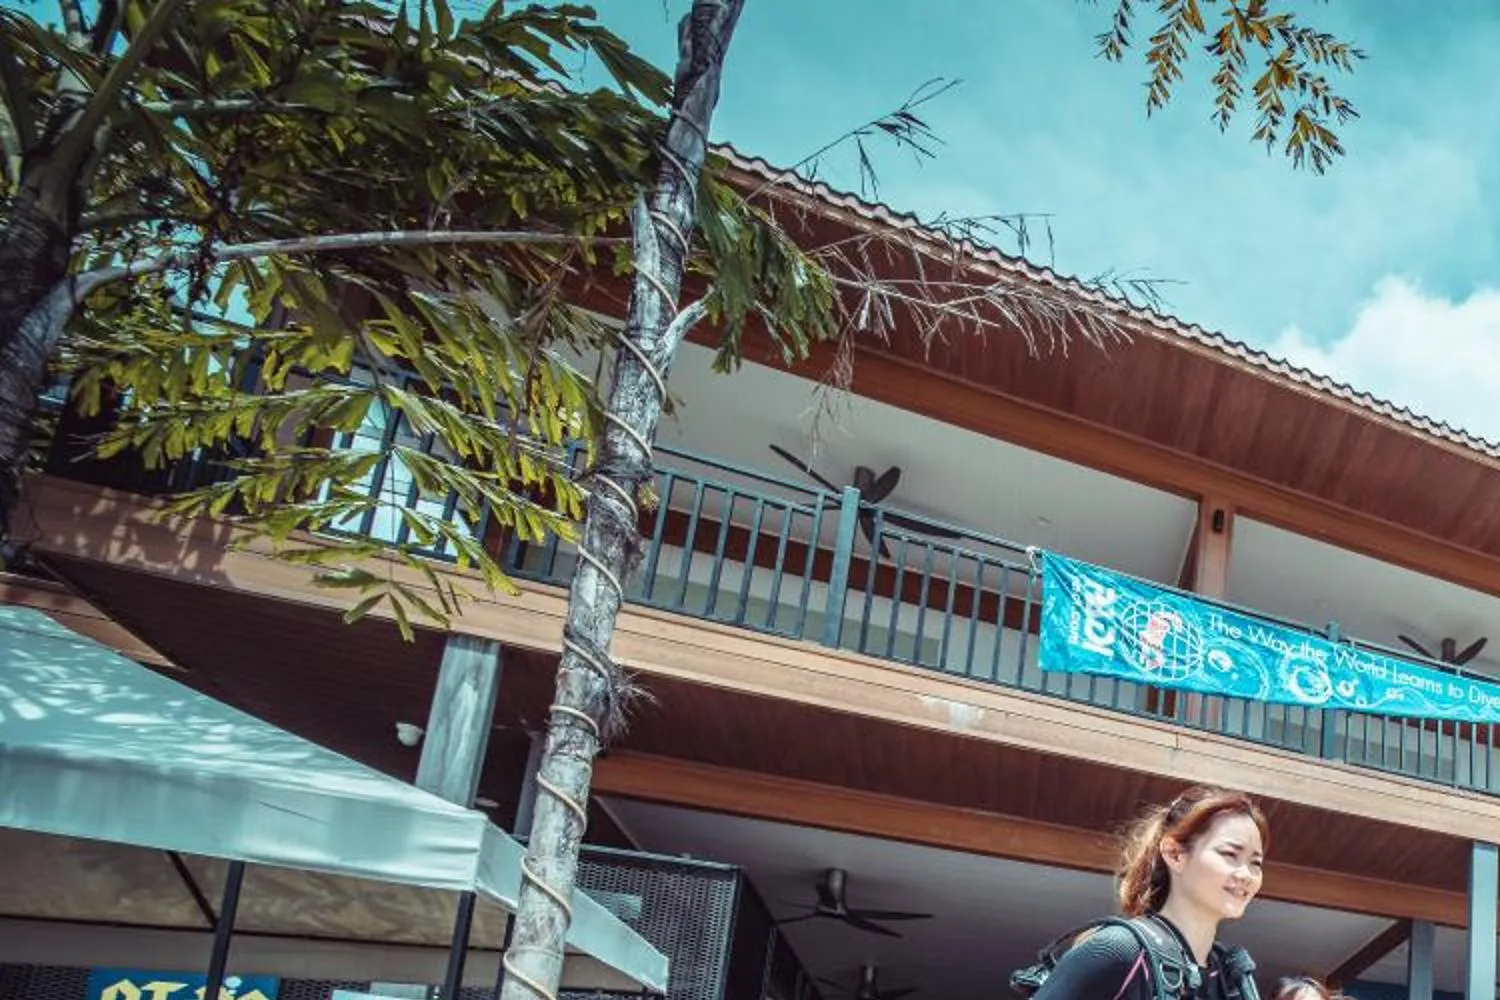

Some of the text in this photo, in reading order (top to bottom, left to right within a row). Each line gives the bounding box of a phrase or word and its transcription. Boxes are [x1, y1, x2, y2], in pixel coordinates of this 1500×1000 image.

[1208, 612, 1241, 639] The
[1249, 624, 1291, 658] Way
[1300, 641, 1325, 659] the
[1334, 645, 1387, 678] World
[1393, 664, 1443, 694] Learns
[1448, 683, 1464, 699] to
